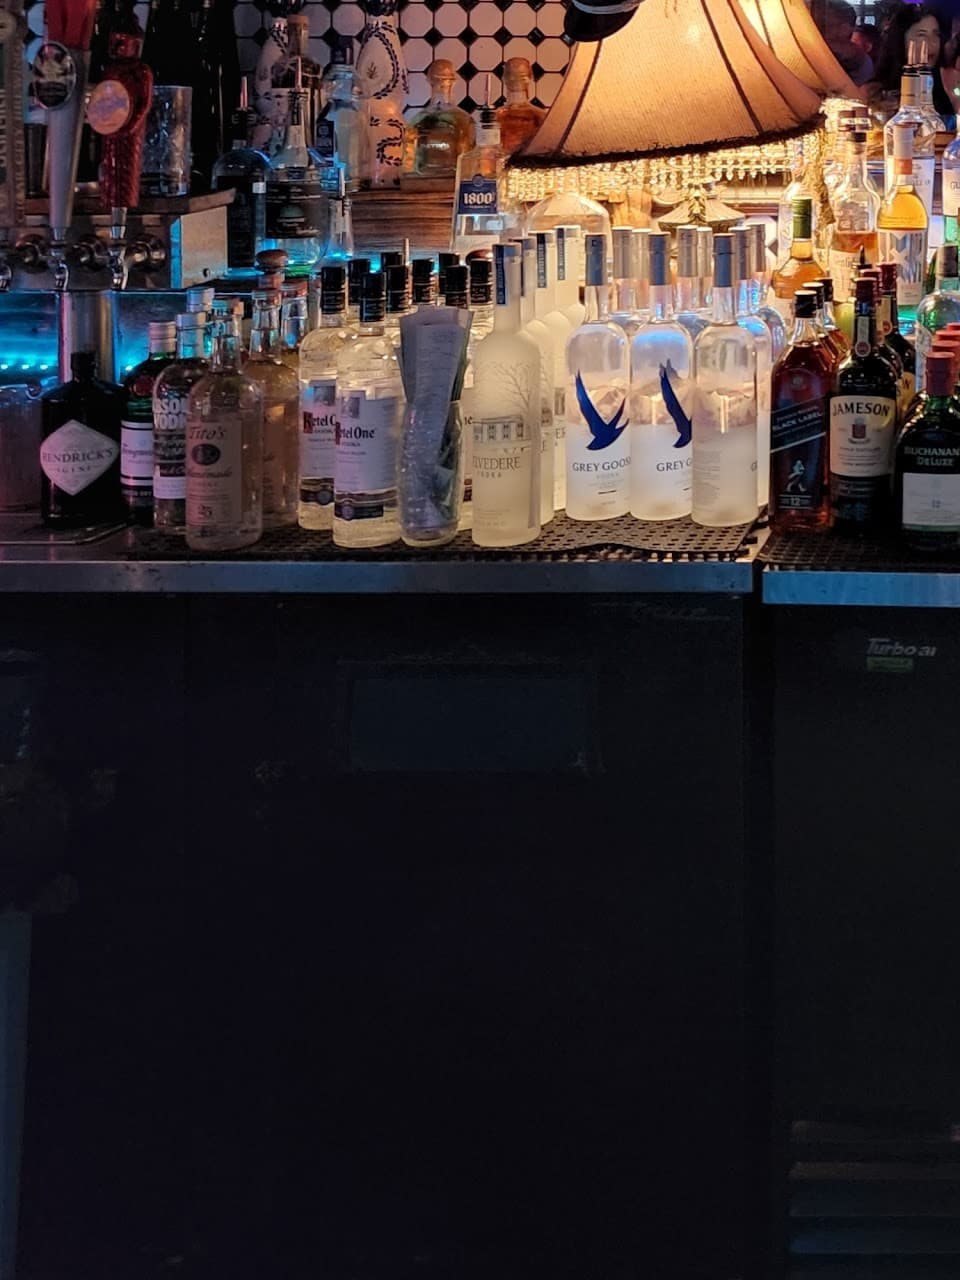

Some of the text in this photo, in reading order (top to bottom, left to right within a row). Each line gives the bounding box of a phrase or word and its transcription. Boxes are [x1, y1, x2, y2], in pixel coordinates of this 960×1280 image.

[463, 192, 492, 205] 1800
[832, 401, 891, 417] JAMESON
[354, 426, 375, 440] One
[572, 461, 600, 473] GREY
[656, 460, 685, 473] GREY
[866, 637, 917, 656] Turbo
